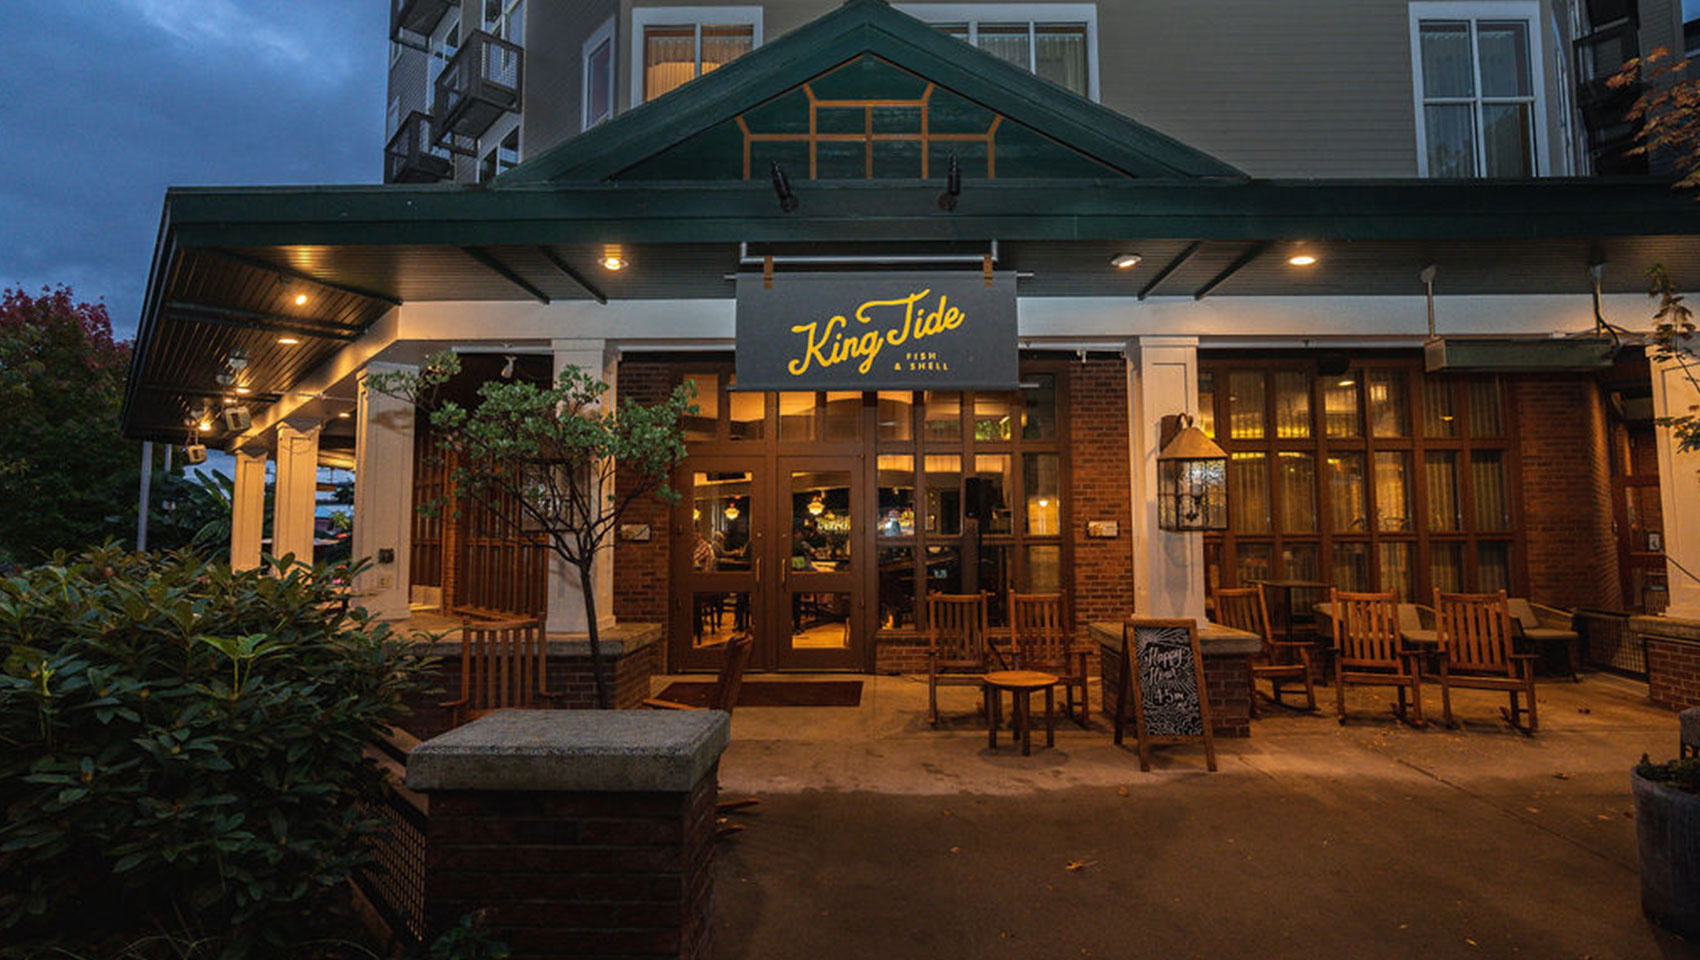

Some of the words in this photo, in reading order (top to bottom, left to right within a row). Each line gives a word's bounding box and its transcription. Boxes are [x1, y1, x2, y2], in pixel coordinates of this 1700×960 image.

[788, 315, 884, 375] King
[855, 288, 965, 345] Tide
[906, 352, 936, 360] FISH
[894, 362, 901, 370] &
[910, 362, 948, 370] SHELL
[1147, 646, 1182, 668] Happy
